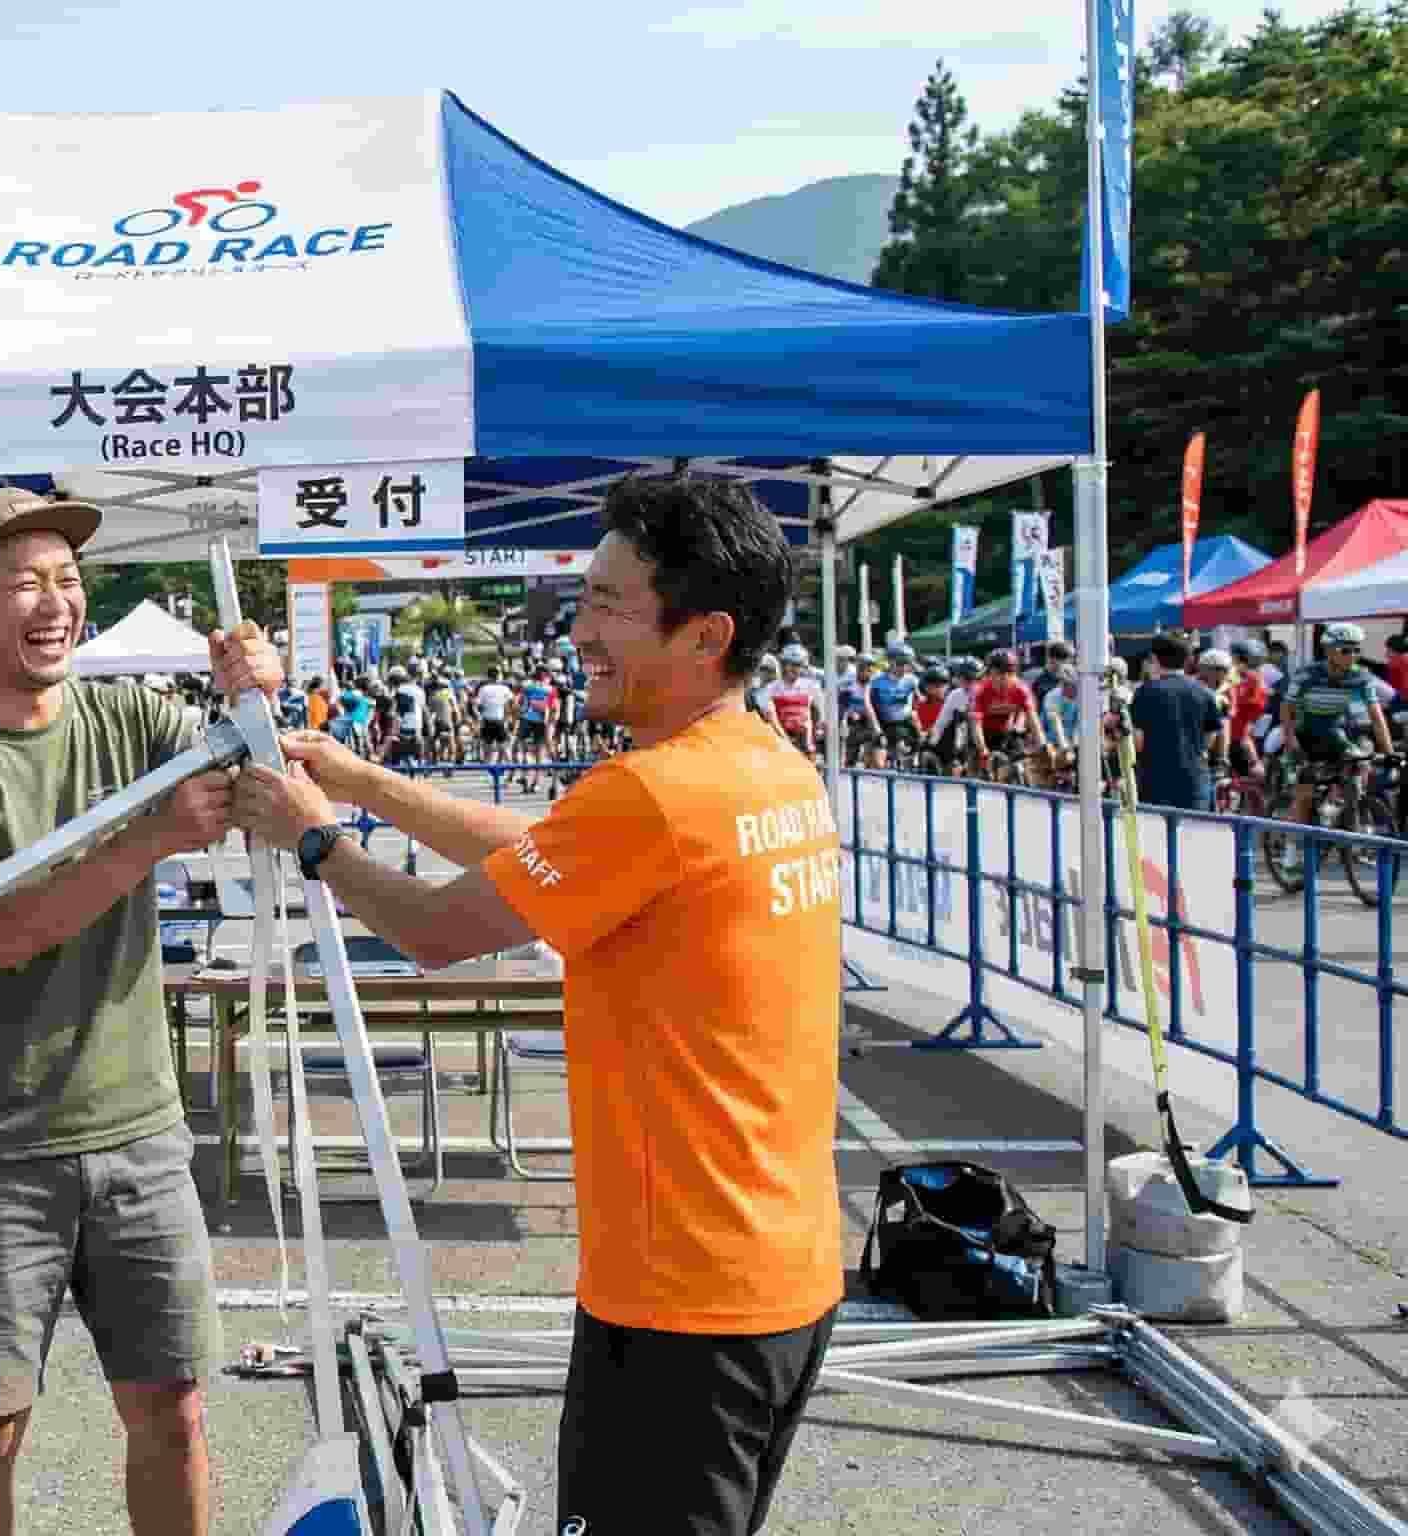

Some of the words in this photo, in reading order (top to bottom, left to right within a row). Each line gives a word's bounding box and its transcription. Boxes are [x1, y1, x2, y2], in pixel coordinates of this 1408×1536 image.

[2, 240, 190, 268] ROAD
[207, 222, 392, 264] RACE
[50, 364, 295, 428] 大会本部
[100, 432, 181, 462] (Race
[191, 430, 247, 458] HQ)
[464, 547, 527, 566] START
